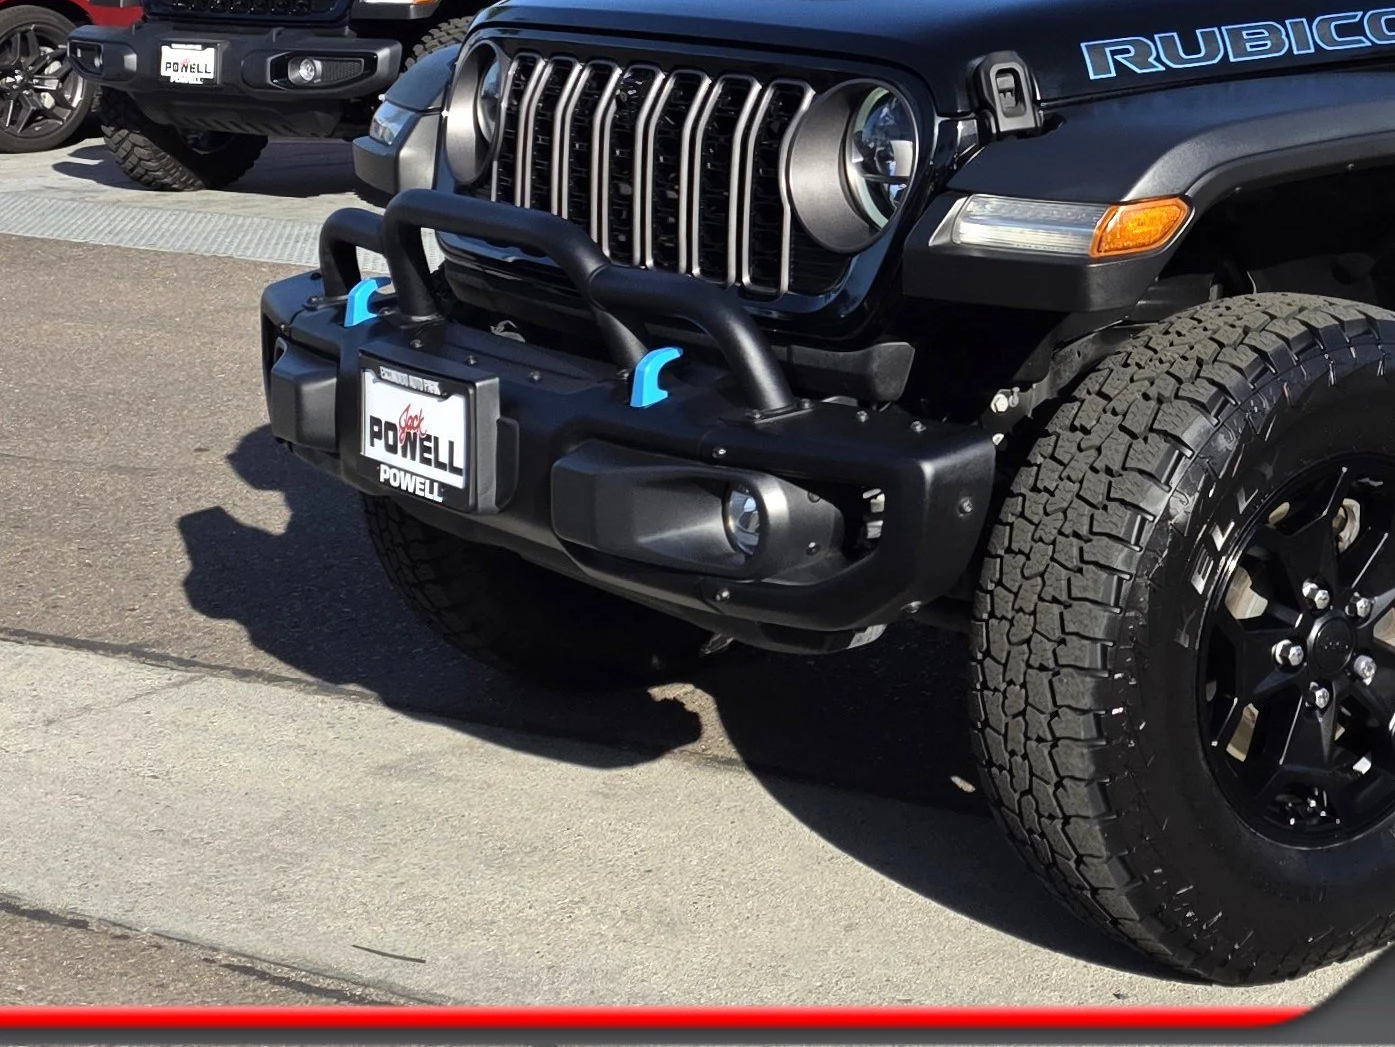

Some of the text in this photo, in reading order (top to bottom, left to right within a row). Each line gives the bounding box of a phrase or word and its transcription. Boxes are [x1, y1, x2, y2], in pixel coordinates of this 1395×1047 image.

[165, 61, 212, 74] POWELL
[399, 403, 427, 446] Jack
[370, 415, 464, 477] POWELL
[380, 464, 444, 503] POWELL
